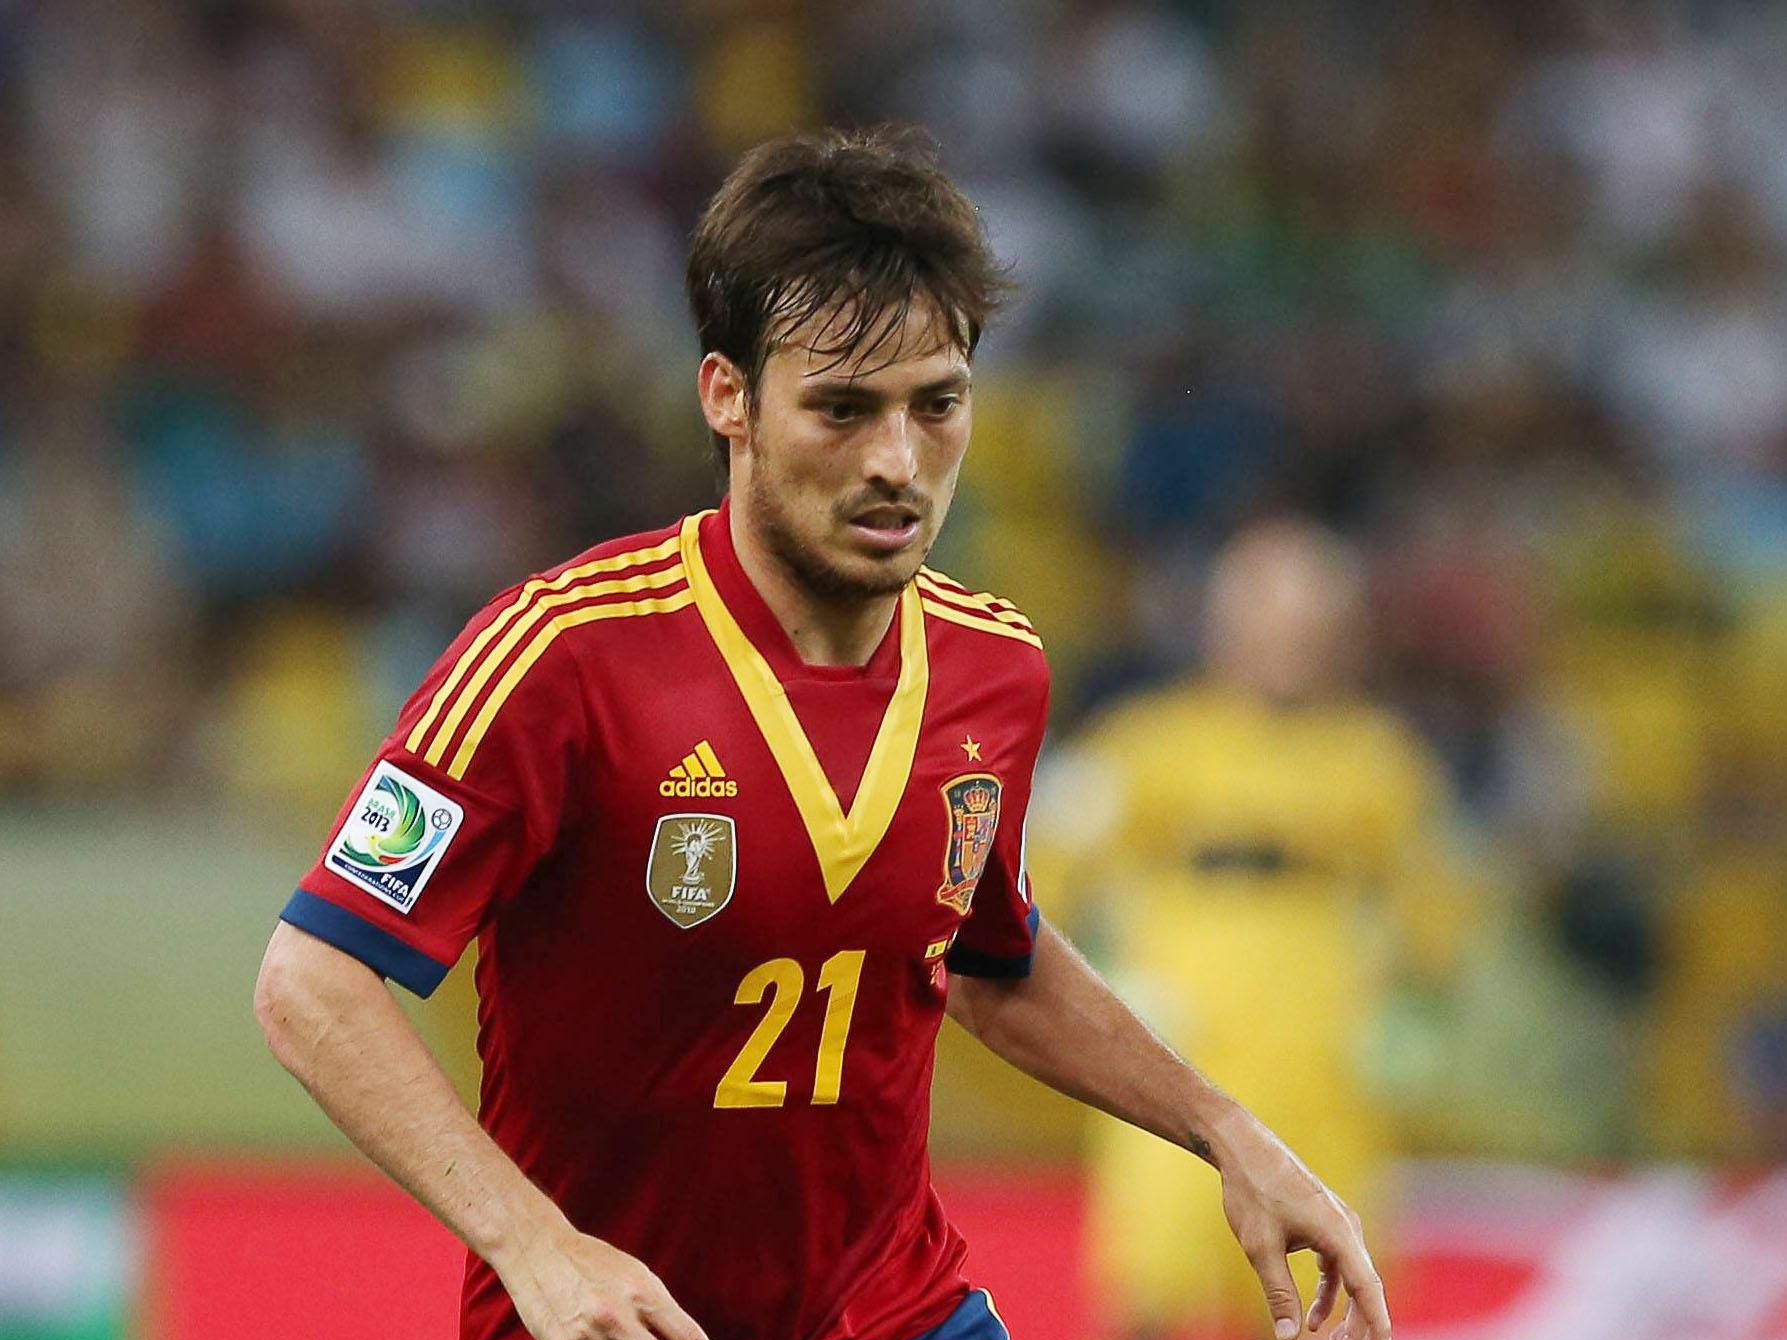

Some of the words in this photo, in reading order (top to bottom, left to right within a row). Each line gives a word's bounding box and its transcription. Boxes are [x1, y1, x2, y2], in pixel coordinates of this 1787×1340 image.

[659, 776, 738, 797] adidas
[361, 806, 390, 832] 2013
[380, 873, 410, 898] FIFA
[672, 885, 708, 900] FIFA
[713, 950, 866, 1109] 21
